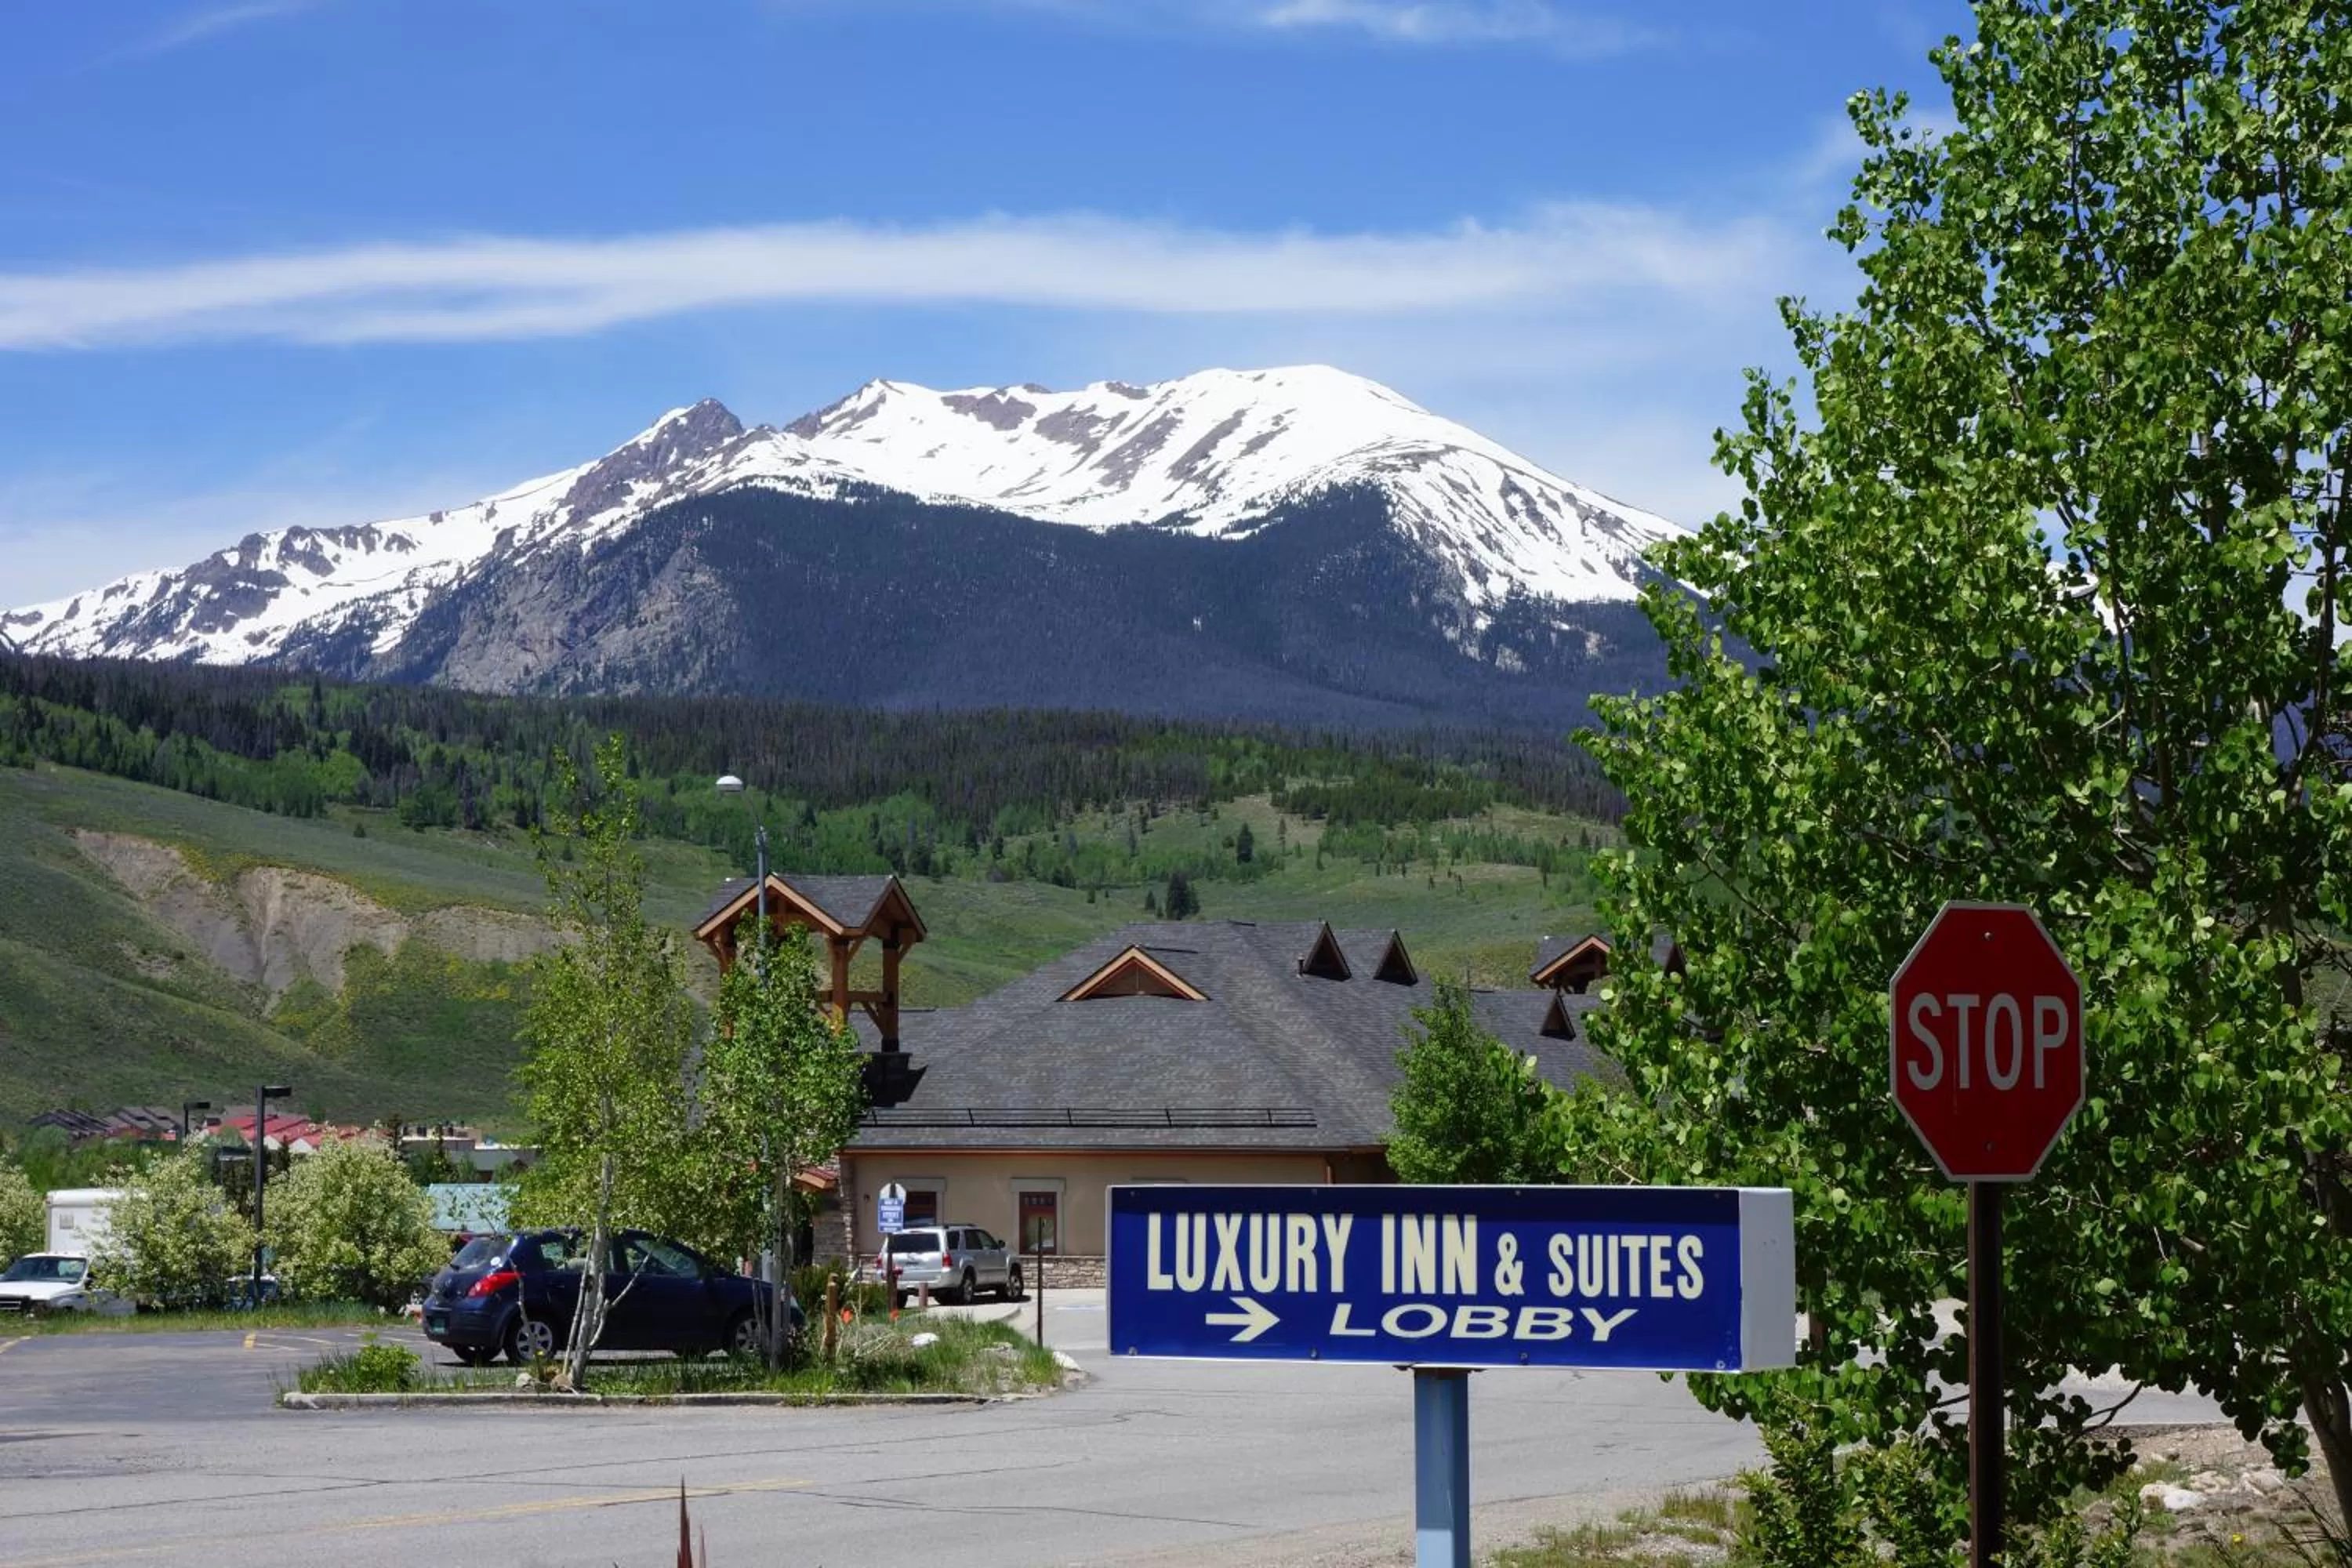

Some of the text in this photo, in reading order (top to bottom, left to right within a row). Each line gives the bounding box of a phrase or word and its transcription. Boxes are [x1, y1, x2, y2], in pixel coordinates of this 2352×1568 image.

[1907, 993, 2069, 1091] STOP
[1147, 1213, 1704, 1299] LUXURY INN & SUITES
[1330, 1304, 1639, 1341] LOBBY
